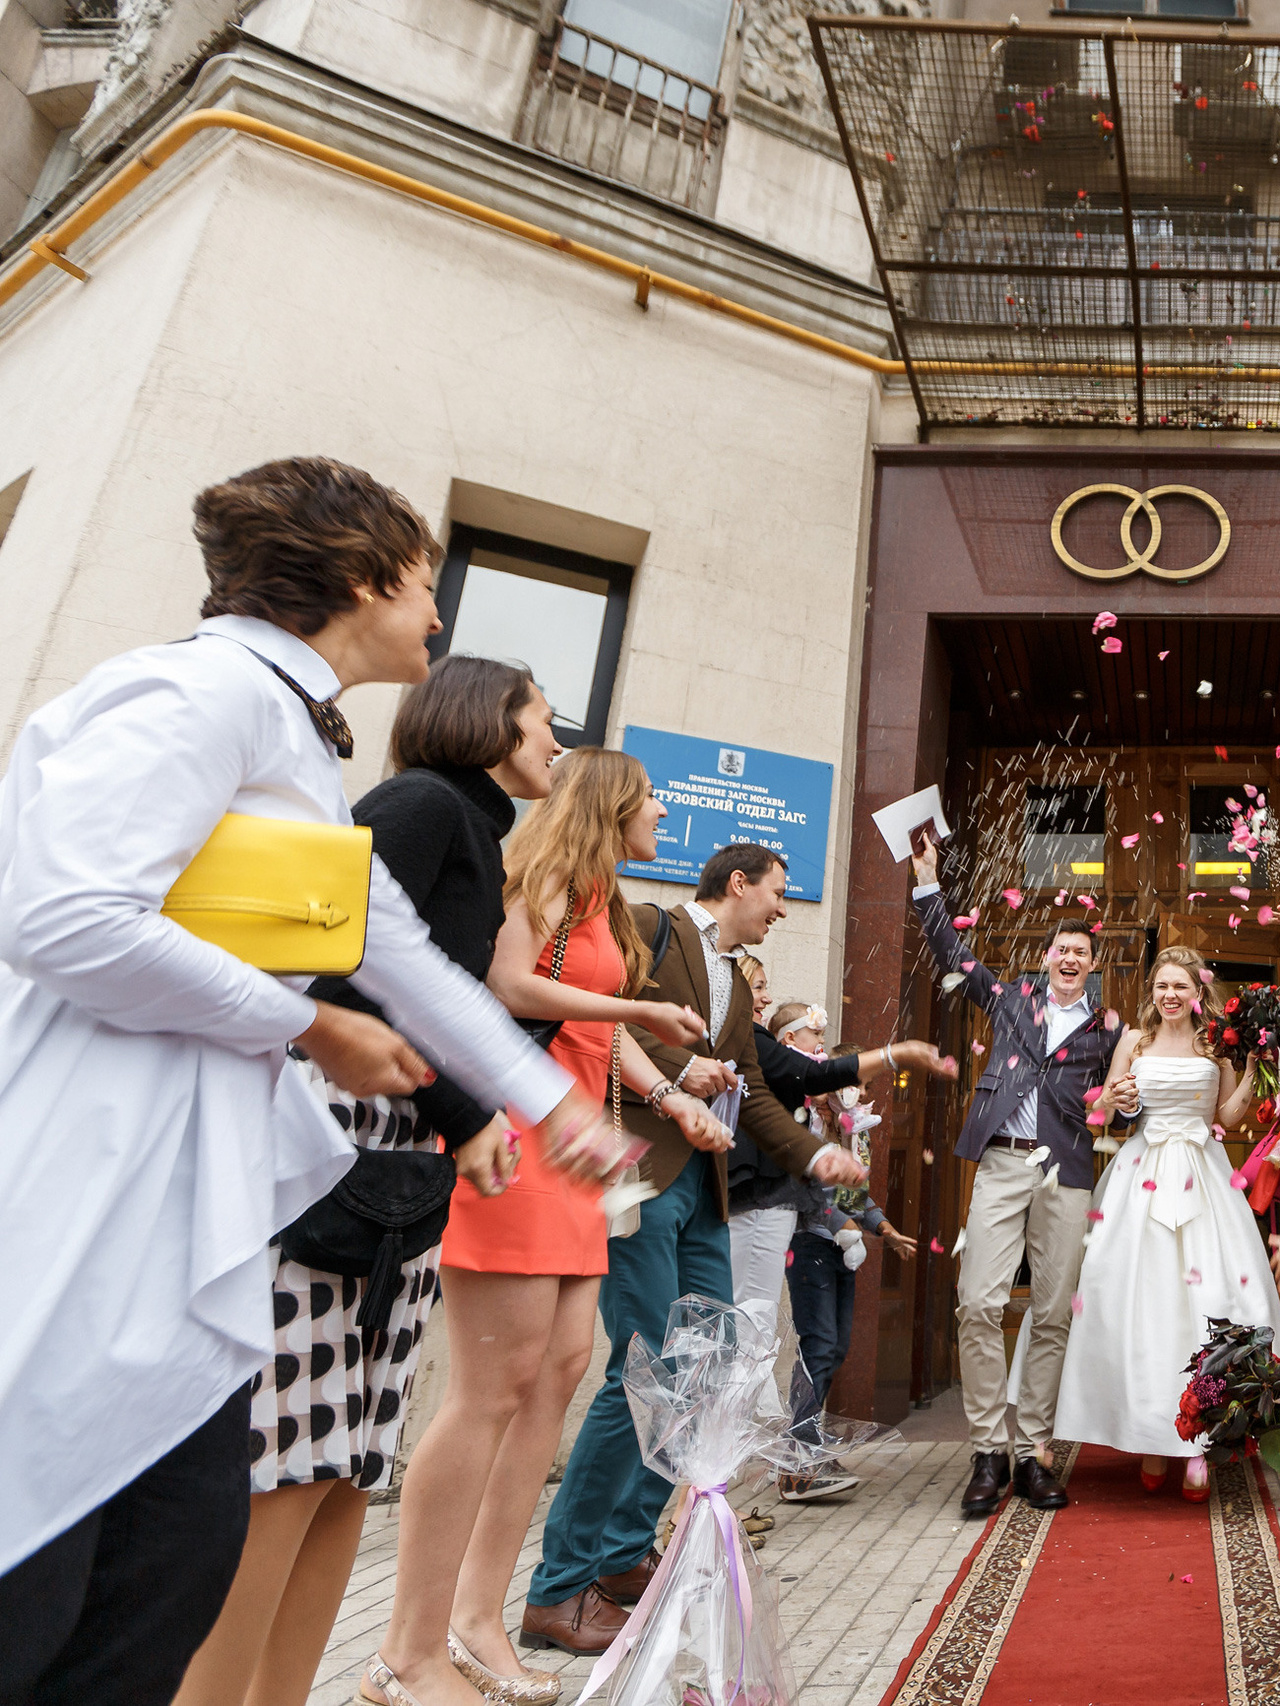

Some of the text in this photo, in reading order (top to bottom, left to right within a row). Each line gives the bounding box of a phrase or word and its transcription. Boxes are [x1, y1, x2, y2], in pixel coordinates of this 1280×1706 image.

[667, 780, 786, 808] УПРАВЛЕНИЕ ЗАГС МОСКВЫ
[688, 774, 769, 794] ПРАВИТЕЛЬСТВО МОСКВЫ
[652, 788, 807, 825] ТУЗОВСКИЙ ОТДЕЛ ЗАГС
[729, 834, 750, 844] 9.00
[758, 838, 783, 850] 18.00
